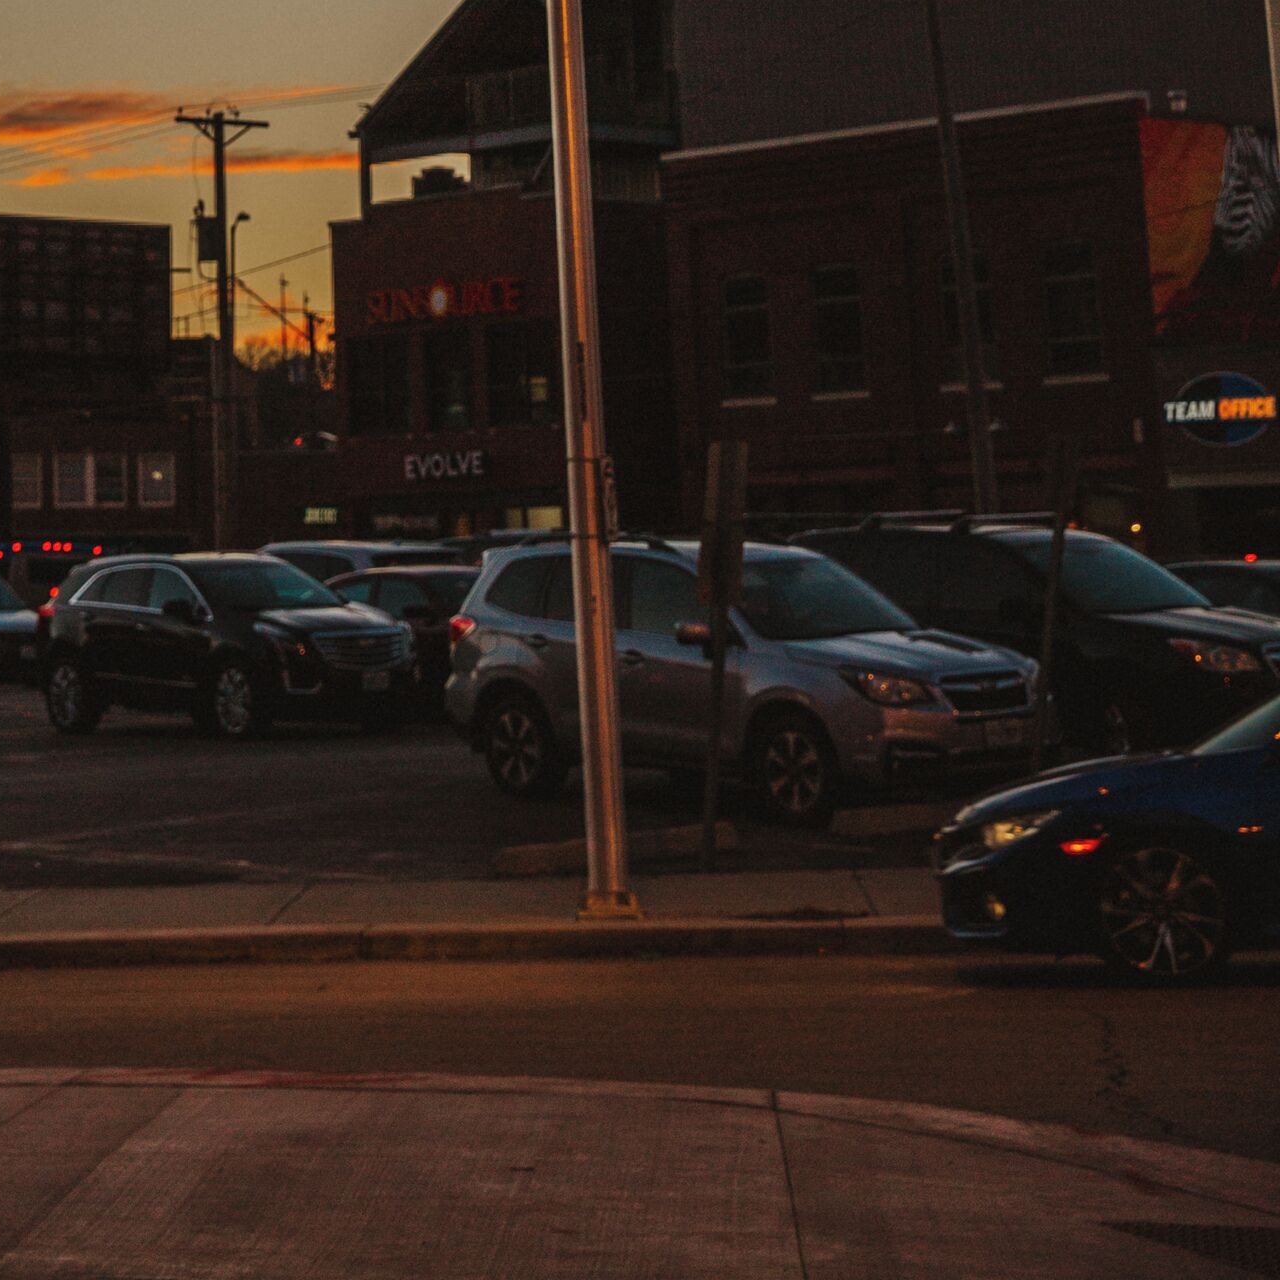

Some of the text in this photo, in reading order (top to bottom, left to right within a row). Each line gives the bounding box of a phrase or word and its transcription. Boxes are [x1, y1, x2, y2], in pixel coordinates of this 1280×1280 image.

[1163, 395, 1276, 422] TEAM OFFICE
[403, 450, 484, 479] EVOLVE
